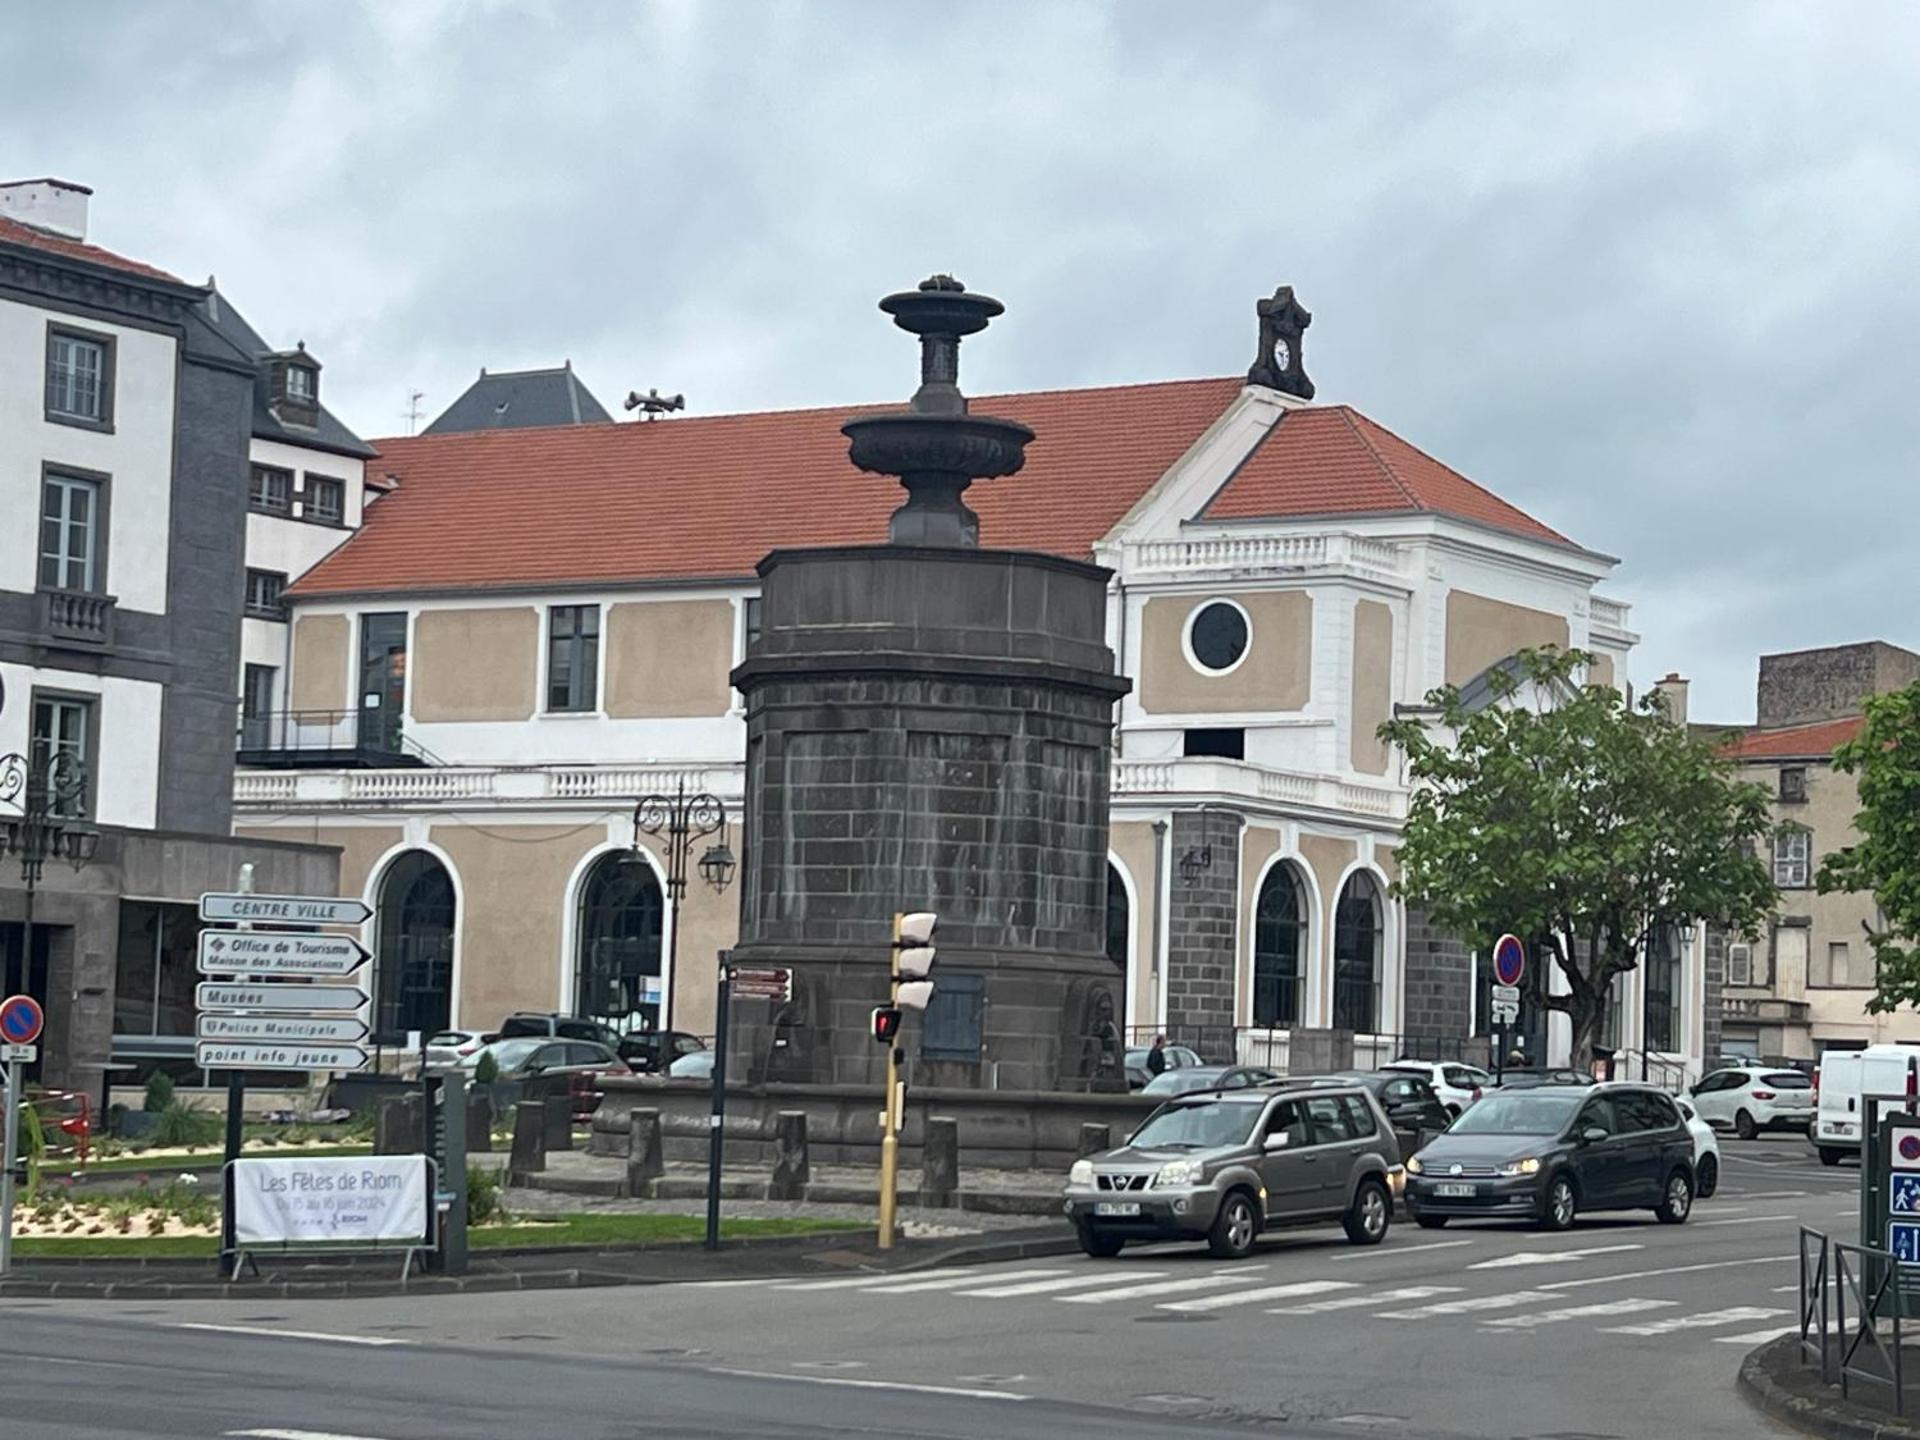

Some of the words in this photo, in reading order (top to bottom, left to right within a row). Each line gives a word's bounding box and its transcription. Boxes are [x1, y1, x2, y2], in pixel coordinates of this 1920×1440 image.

[232, 901, 290, 916] CENTRE
[231, 939, 269, 951] Office
[274, 940, 290, 953] de
[296, 942, 349, 955] Tourisme
[208, 956, 247, 965] Maison
[252, 957, 271, 967] des
[276, 958, 344, 968] Associations
[207, 990, 263, 1004] Musées
[219, 1022, 259, 1032] Police
[265, 1023, 337, 1036] Municipale
[204, 1050, 247, 1062] point
[254, 1050, 286, 1062] info
[294, 1052, 338, 1066] jeune
[260, 1172, 287, 1192] Les
[292, 1171, 334, 1191] Fêtes
[338, 1172, 358, 1190] de
[361, 1171, 401, 1190] Riom
